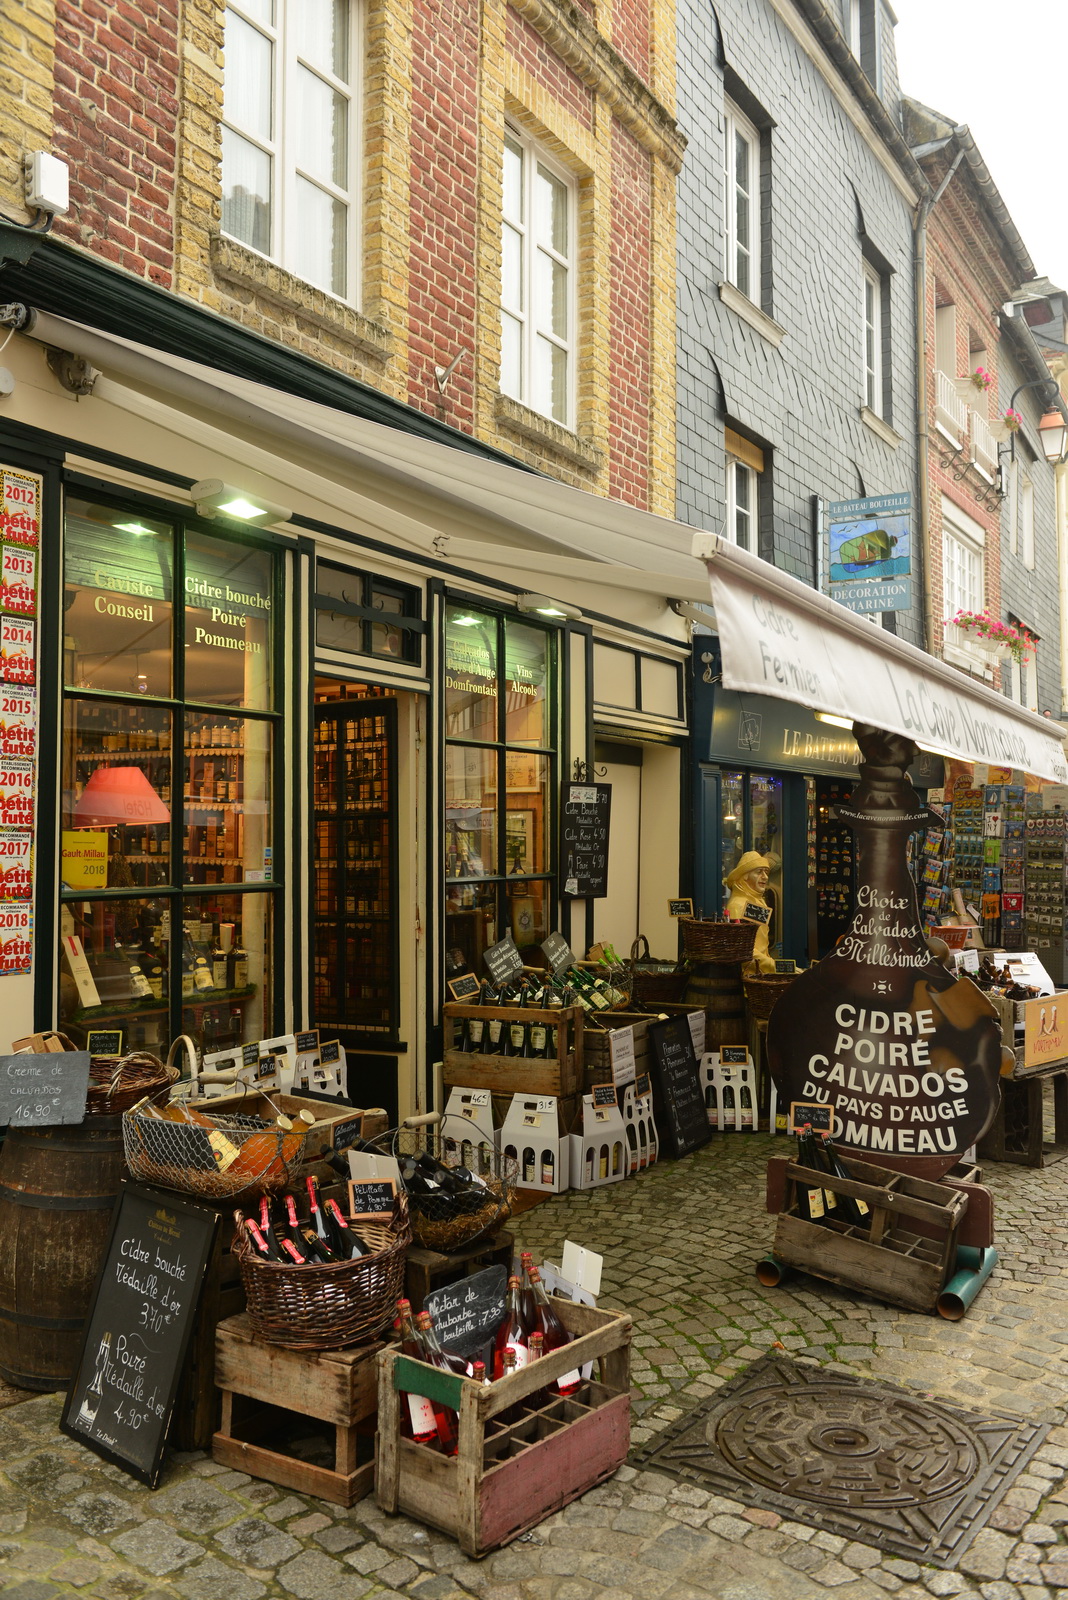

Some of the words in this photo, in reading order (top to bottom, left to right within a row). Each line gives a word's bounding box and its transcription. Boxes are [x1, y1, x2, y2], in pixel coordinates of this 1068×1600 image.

[6, 485, 34, 505] 2012
[833, 506, 842, 514] LE
[843, 502, 868, 513] BATEAU
[869, 497, 909, 508] BOUTEILLE
[0, 513, 39, 532] petit
[6, 525, 38, 546] futé
[4, 556, 33, 574] 2013
[95, 570, 153, 597] Caviste
[833, 584, 907, 601] DECORATION
[0, 585, 37, 602] petit
[184, 577, 222, 599] Cidre
[226, 586, 271, 610] bouché
[4, 597, 36, 615] futé
[95, 596, 153, 622] Conseil
[846, 598, 895, 611] MARINE
[211, 606, 247, 628] Poiré
[751, 594, 800, 643] Cidre
[3, 627, 32, 643] 2014
[195, 627, 261, 654] Pommeau
[453, 640, 490, 659] Calvados
[0, 656, 36, 671] petit
[447, 658, 467, 675] Pays
[468, 663, 496, 680] d'Auge
[516, 664, 533, 679] Vins
[758, 640, 823, 698] Fermier
[3, 668, 35, 684] futé
[446, 676, 497, 697] Domfrontais
[511, 681, 538, 697] Alcools
[2, 698, 31, 714] 2015
[917, 680, 961, 749] Cave
[955, 697, 1031, 768] Normande
[2, 740, 34, 755] futé
[783, 729, 801, 756] LE
[804, 734, 849, 765] BATEAU
[0, 772, 31, 787] 2016
[1, 810, 33, 824] futé
[838, 808, 929, 823] www.lacavenormande.com
[0, 842, 29, 855] 2017
[62, 849, 82, 858] Gault
[83, 849, 105, 858] Millau
[83, 865, 105, 875] 2018
[0, 883, 32, 897] futé
[856, 885, 910, 911] Choix
[0, 914, 28, 927] 2018
[878, 911, 892, 922] de
[851, 913, 920, 940] Calvados
[830, 936, 939, 969] Millésimés
[835, 1003, 936, 1036] CIDRE
[834, 1032, 931, 1067] POIRÉ
[51, 1061, 63, 1076] de
[808, 1053, 970, 1100] CALVADOS
[10, 1086, 62, 1095] CALVADOS
[802, 1080, 830, 1105] DU
[835, 1094, 884, 1120] PAYS
[890, 1098, 970, 1123] D'AUGE
[829, 1113, 958, 1154] OMMEAU
[120, 1239, 150, 1264] Cidre
[154, 1246, 187, 1282] bouché
[160, 1286, 181, 1316] d'or
[464, 1287, 479, 1302] de
[434, 1307, 477, 1332] rhubarbe
[443, 1320, 477, 1343] bouteille
[116, 1334, 146, 1374] Poiré
[146, 1386, 166, 1420] d'or
